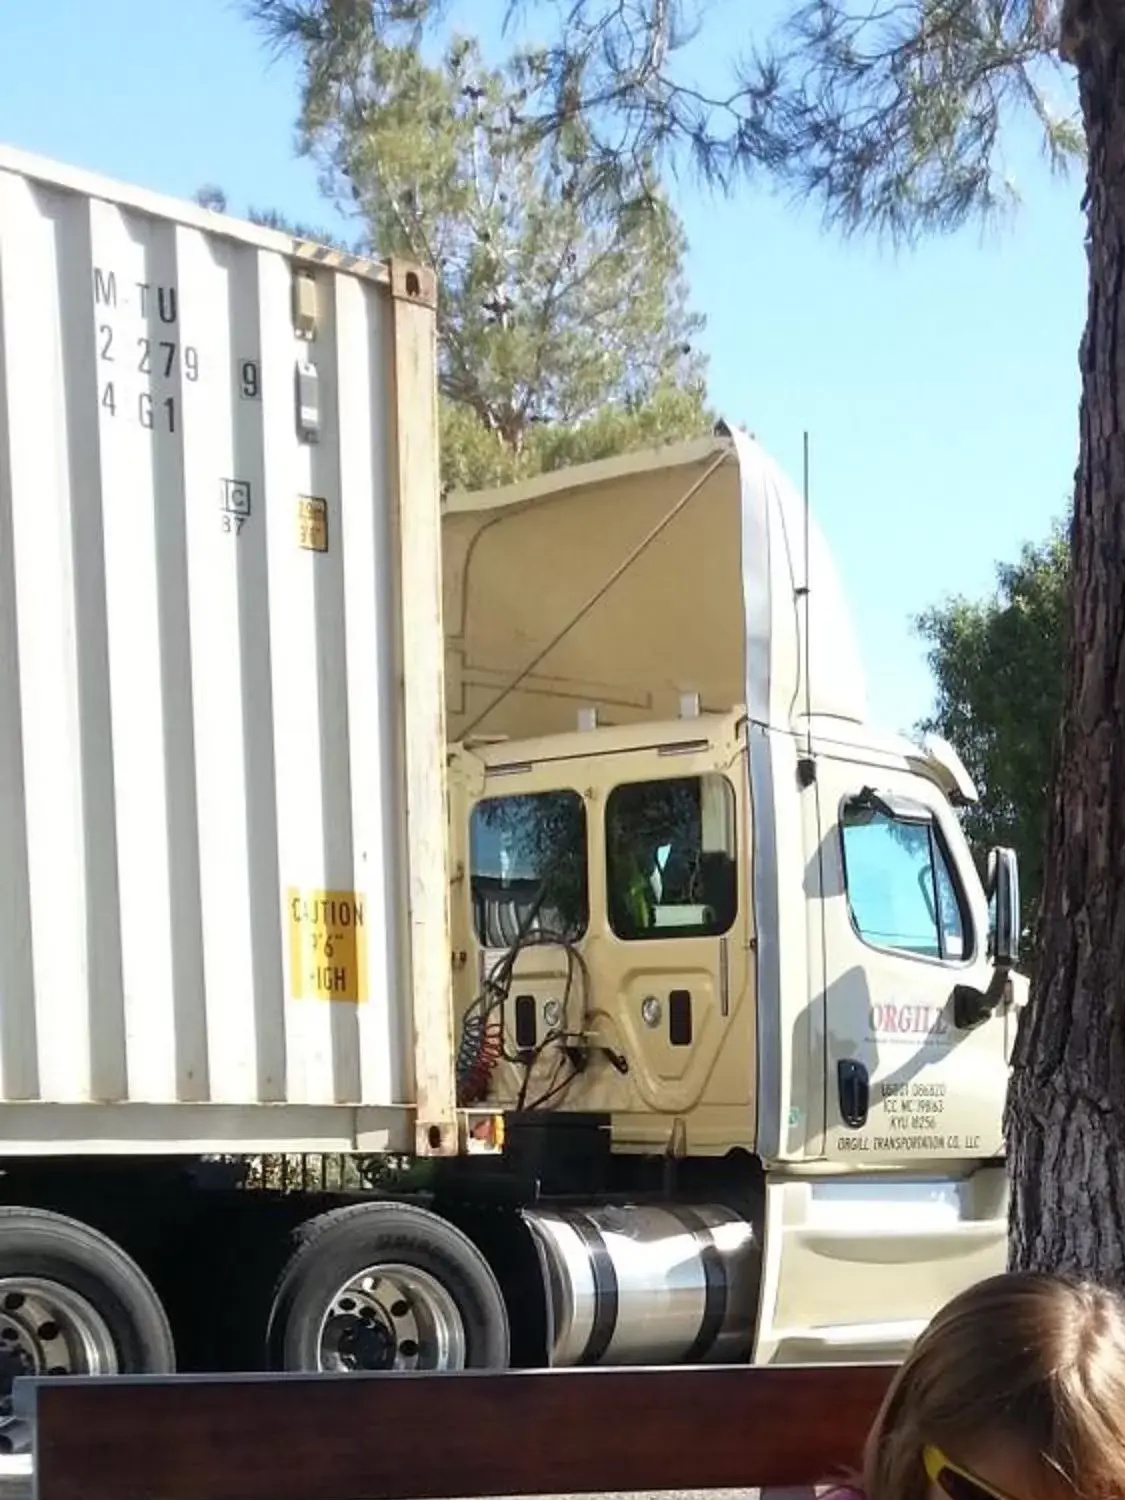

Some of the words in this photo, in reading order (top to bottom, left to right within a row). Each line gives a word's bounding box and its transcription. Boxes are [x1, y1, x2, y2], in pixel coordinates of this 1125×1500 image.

[310, 966, 347, 992] IGH
[868, 1004, 947, 1034] ORGILL
[837, 1137, 870, 1150] ORGILL
[873, 1135, 945, 1150] TRANSPORTATION
[965, 1135, 980, 1149] LLC
